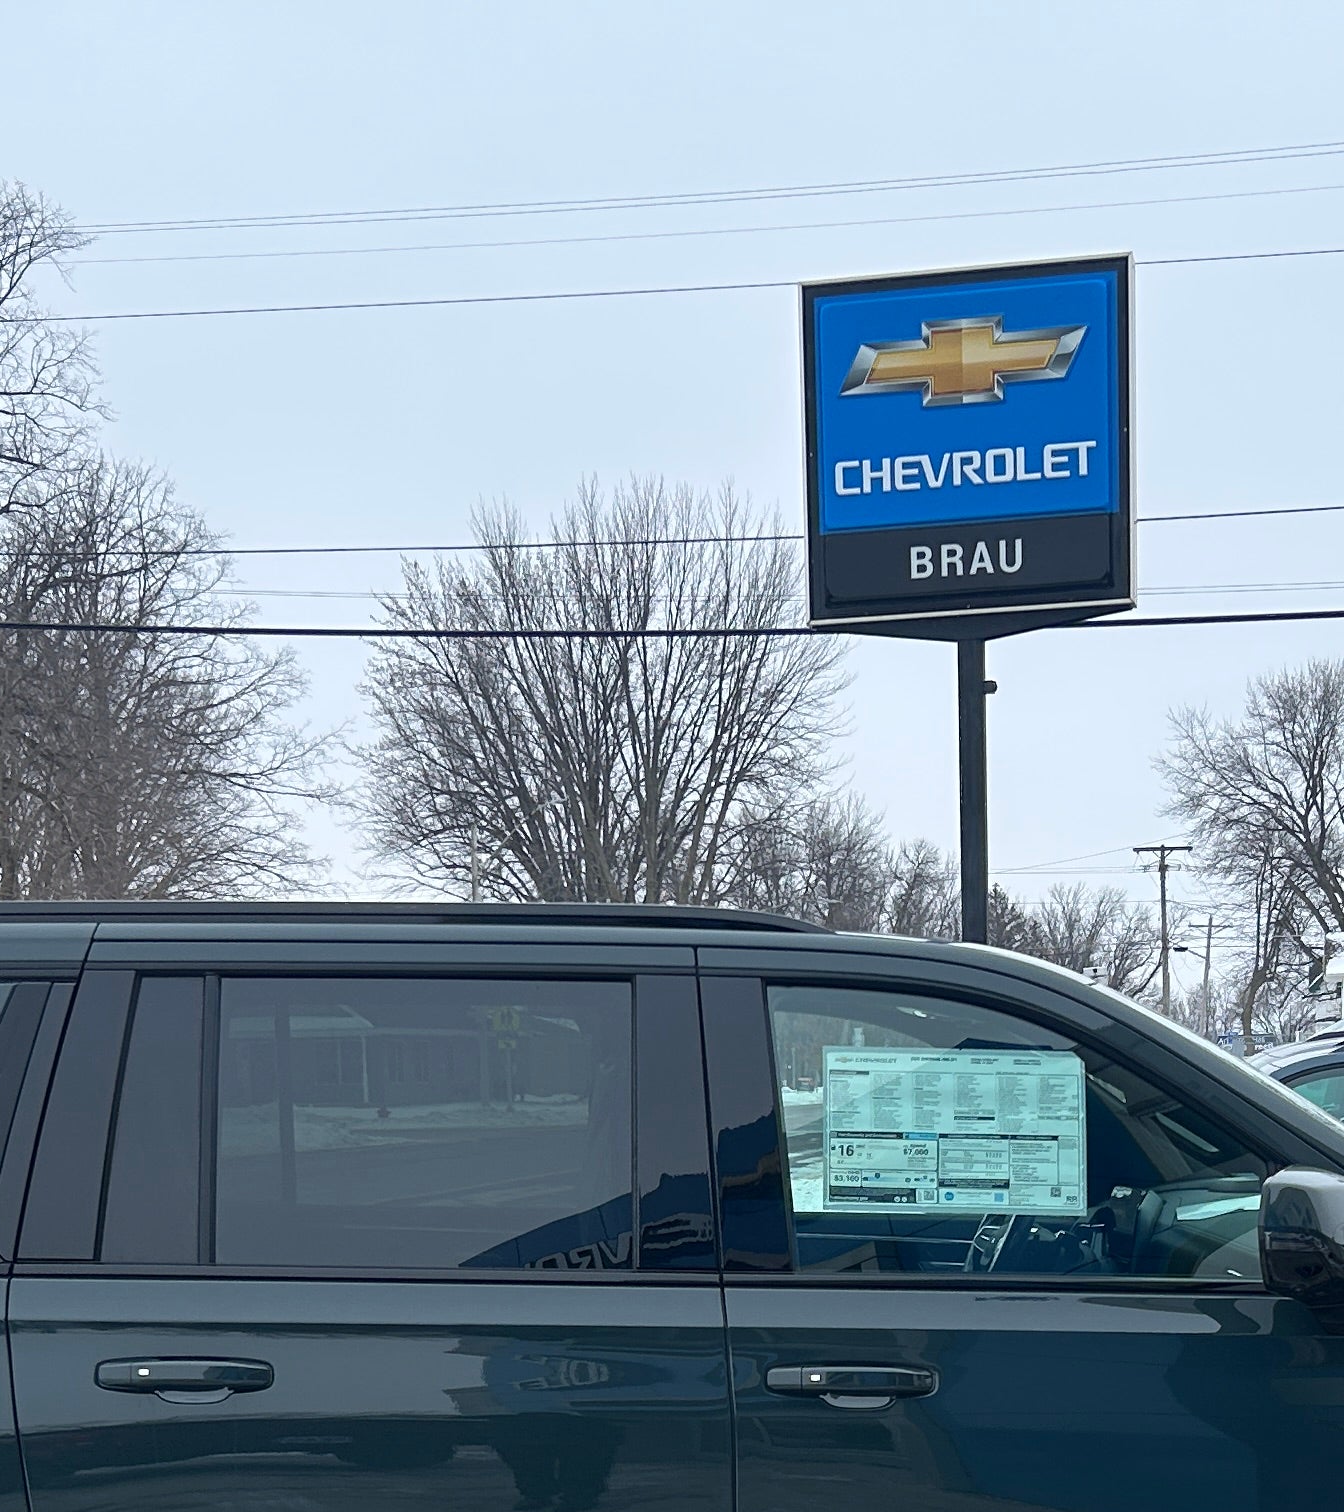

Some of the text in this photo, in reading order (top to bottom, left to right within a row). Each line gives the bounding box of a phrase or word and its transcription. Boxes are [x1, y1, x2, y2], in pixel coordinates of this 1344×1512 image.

[834, 440, 1097, 496] CHEVROLET
[909, 537, 1024, 580] BRAU
[838, 1144, 855, 1157] 16
